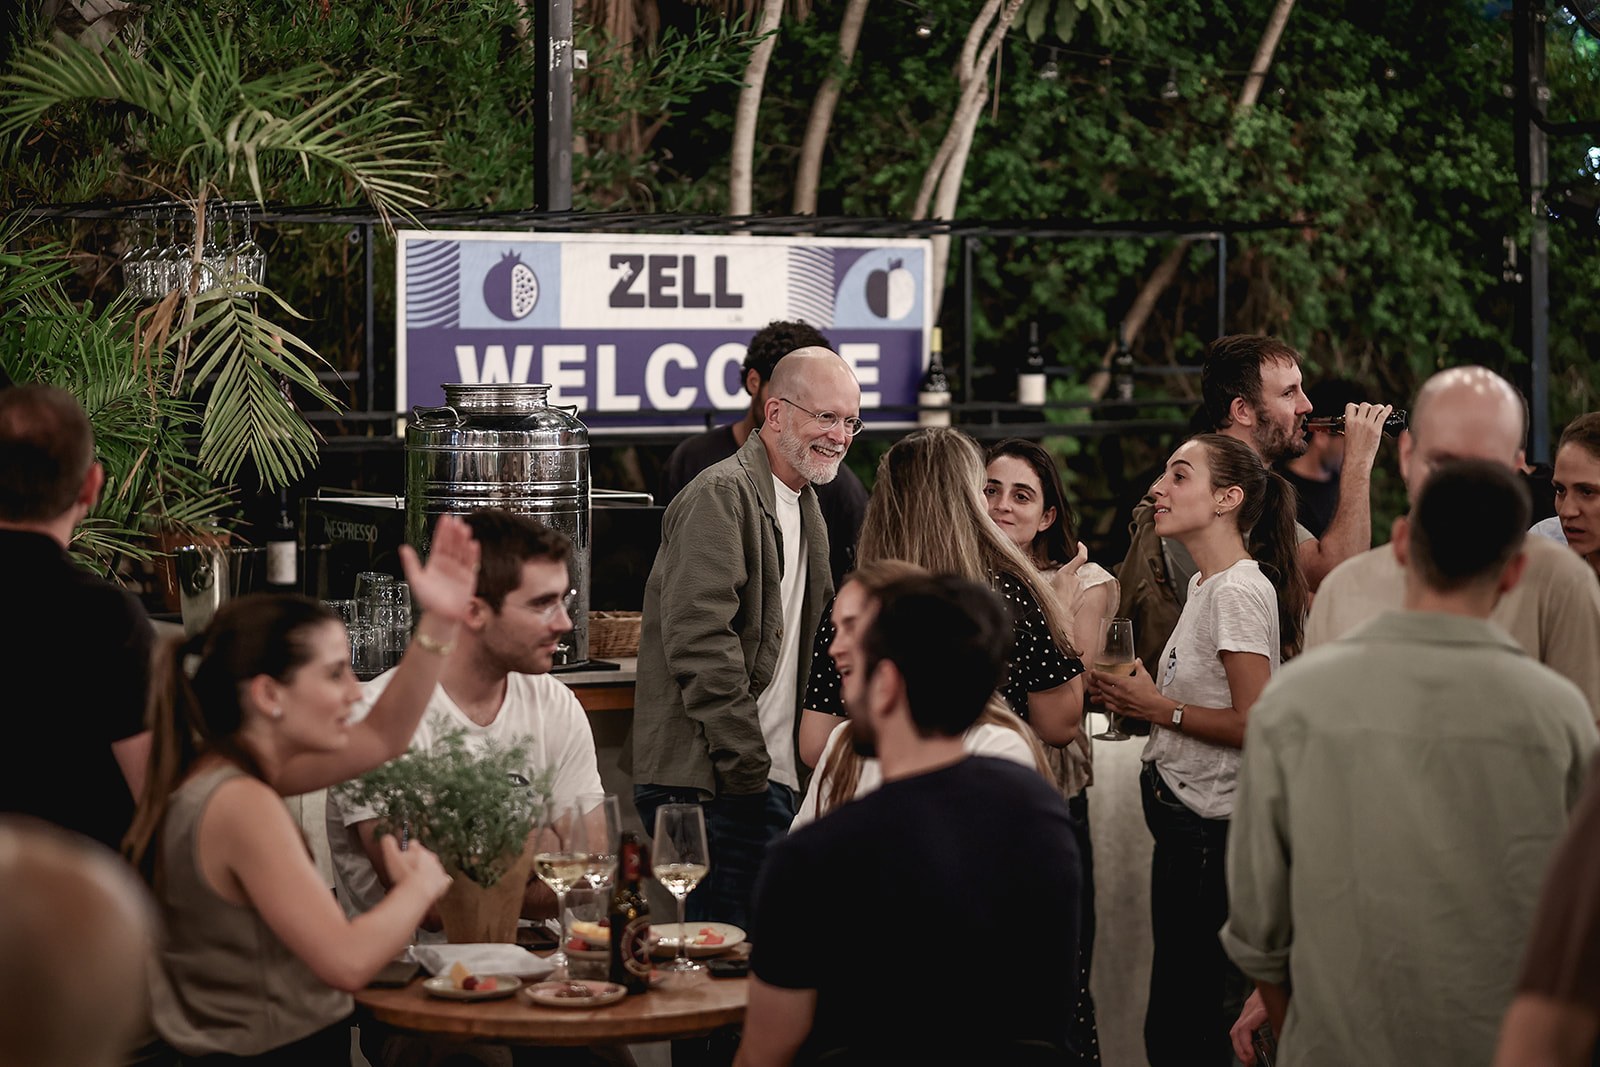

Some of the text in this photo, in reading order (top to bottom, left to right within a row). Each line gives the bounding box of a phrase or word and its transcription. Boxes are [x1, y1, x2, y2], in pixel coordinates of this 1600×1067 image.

[609, 254, 743, 308] ZELL
[454, 343, 881, 411] WELCOE
[322, 516, 378, 542] NESPRESSO
